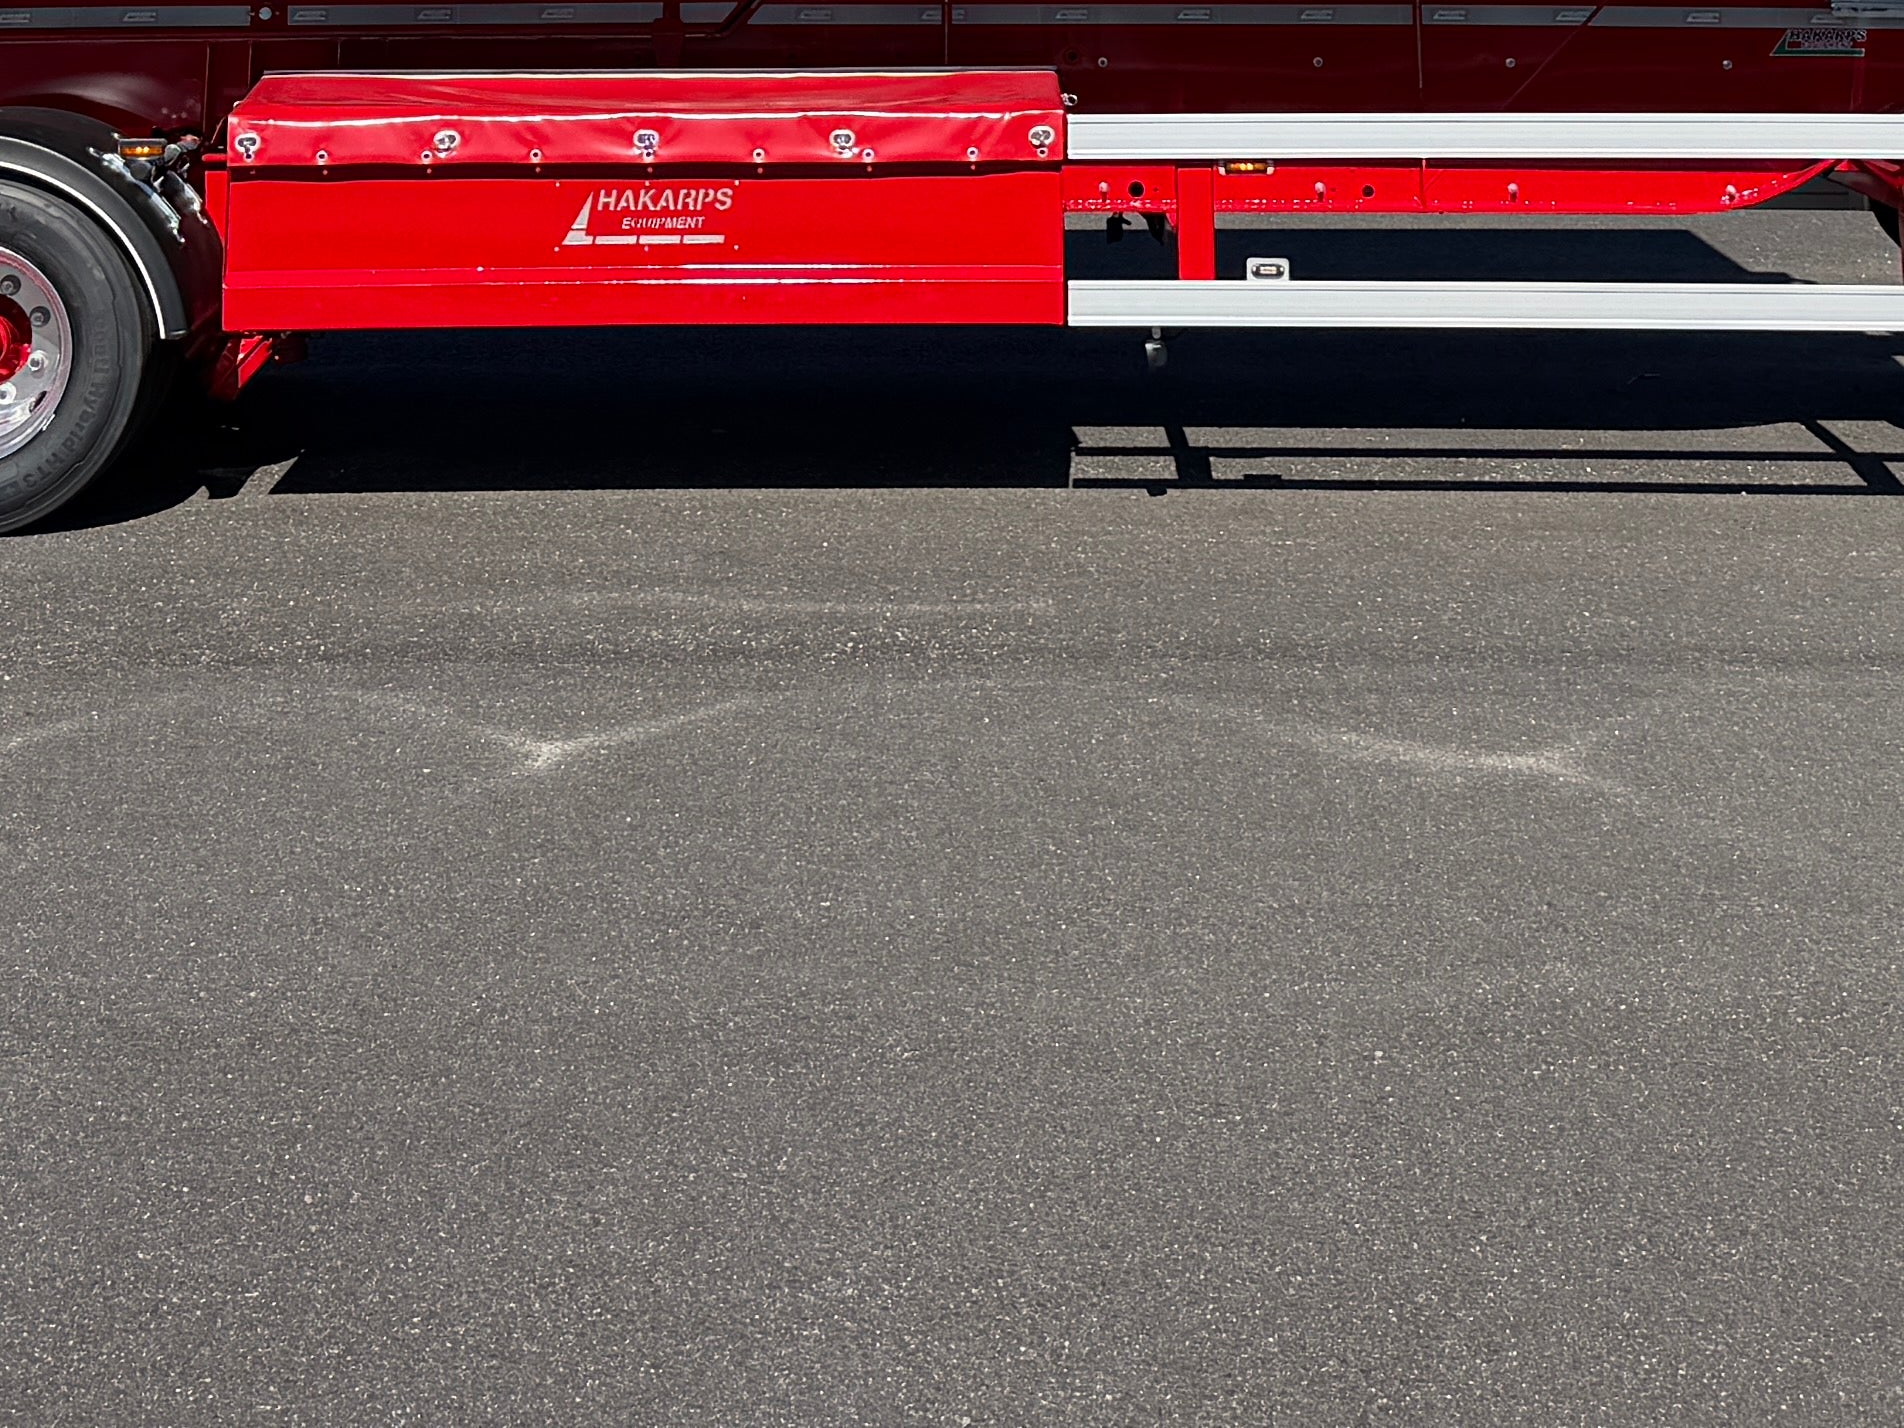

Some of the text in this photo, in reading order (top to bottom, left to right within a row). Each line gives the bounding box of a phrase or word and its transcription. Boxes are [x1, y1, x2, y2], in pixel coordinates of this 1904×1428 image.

[1790, 29, 1867, 42] HAKARPS
[597, 188, 733, 211] HAKARPS
[621, 216, 705, 229] EQUIPMENT
